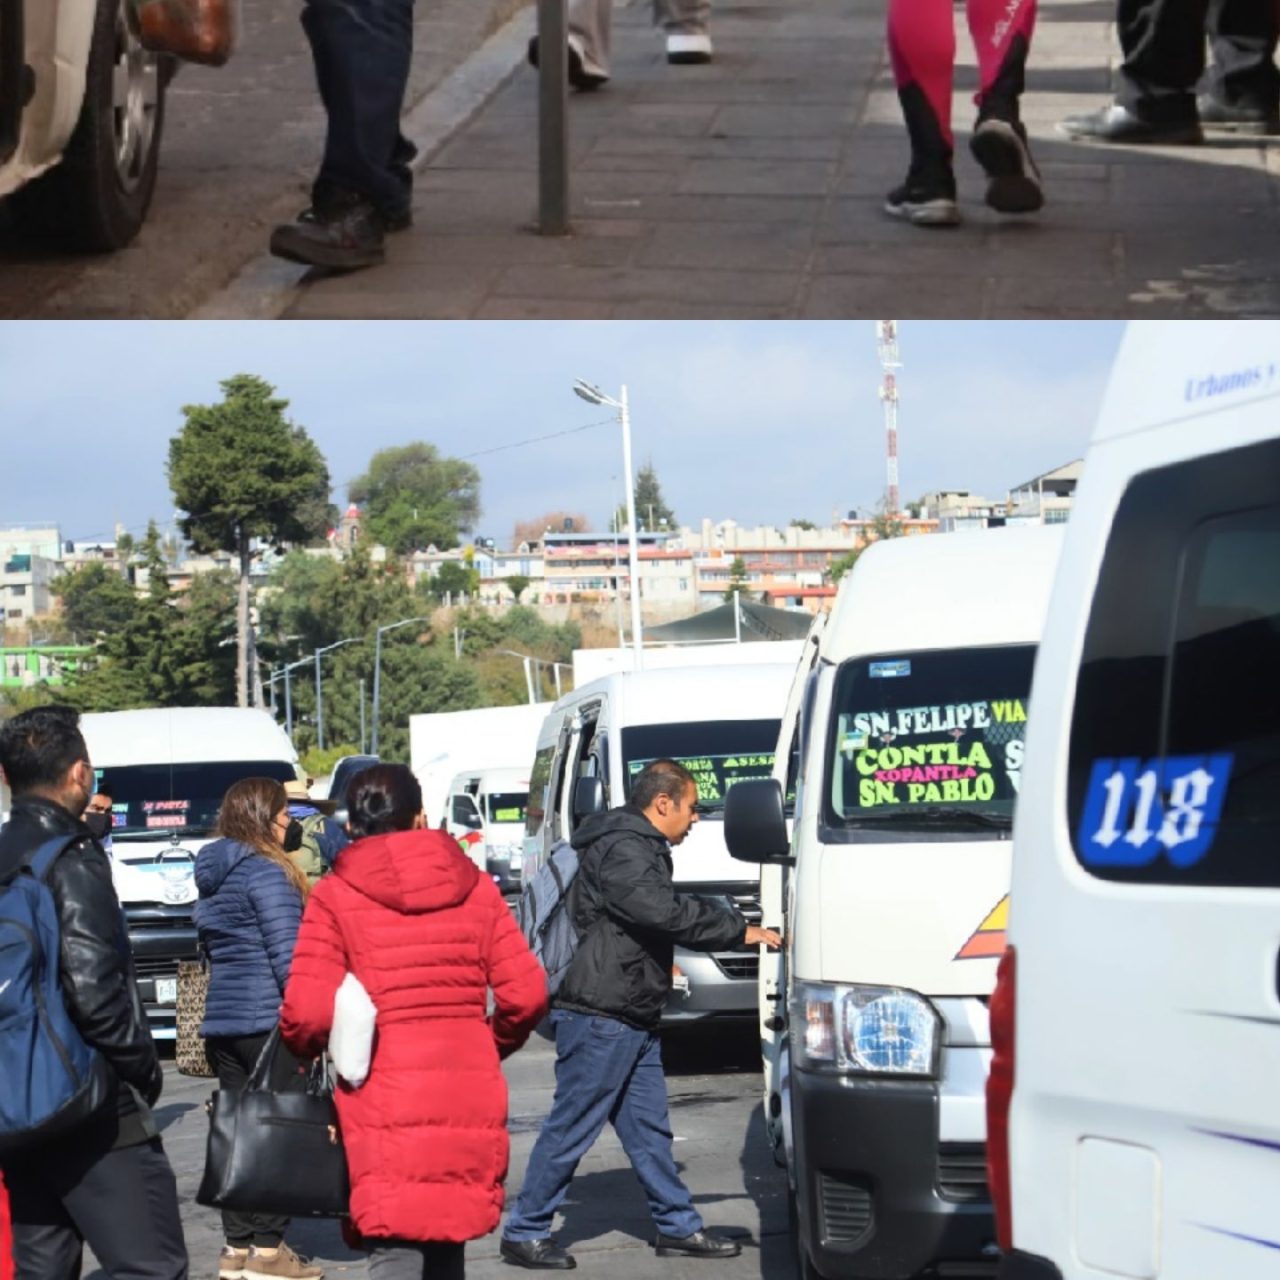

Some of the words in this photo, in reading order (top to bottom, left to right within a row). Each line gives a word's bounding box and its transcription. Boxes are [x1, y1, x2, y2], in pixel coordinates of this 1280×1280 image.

[991, 698, 1027, 723] VIA
[856, 741, 993, 776] CONTLA
[908, 772, 995, 803] PABLO
[1090, 767, 1216, 849] 118
